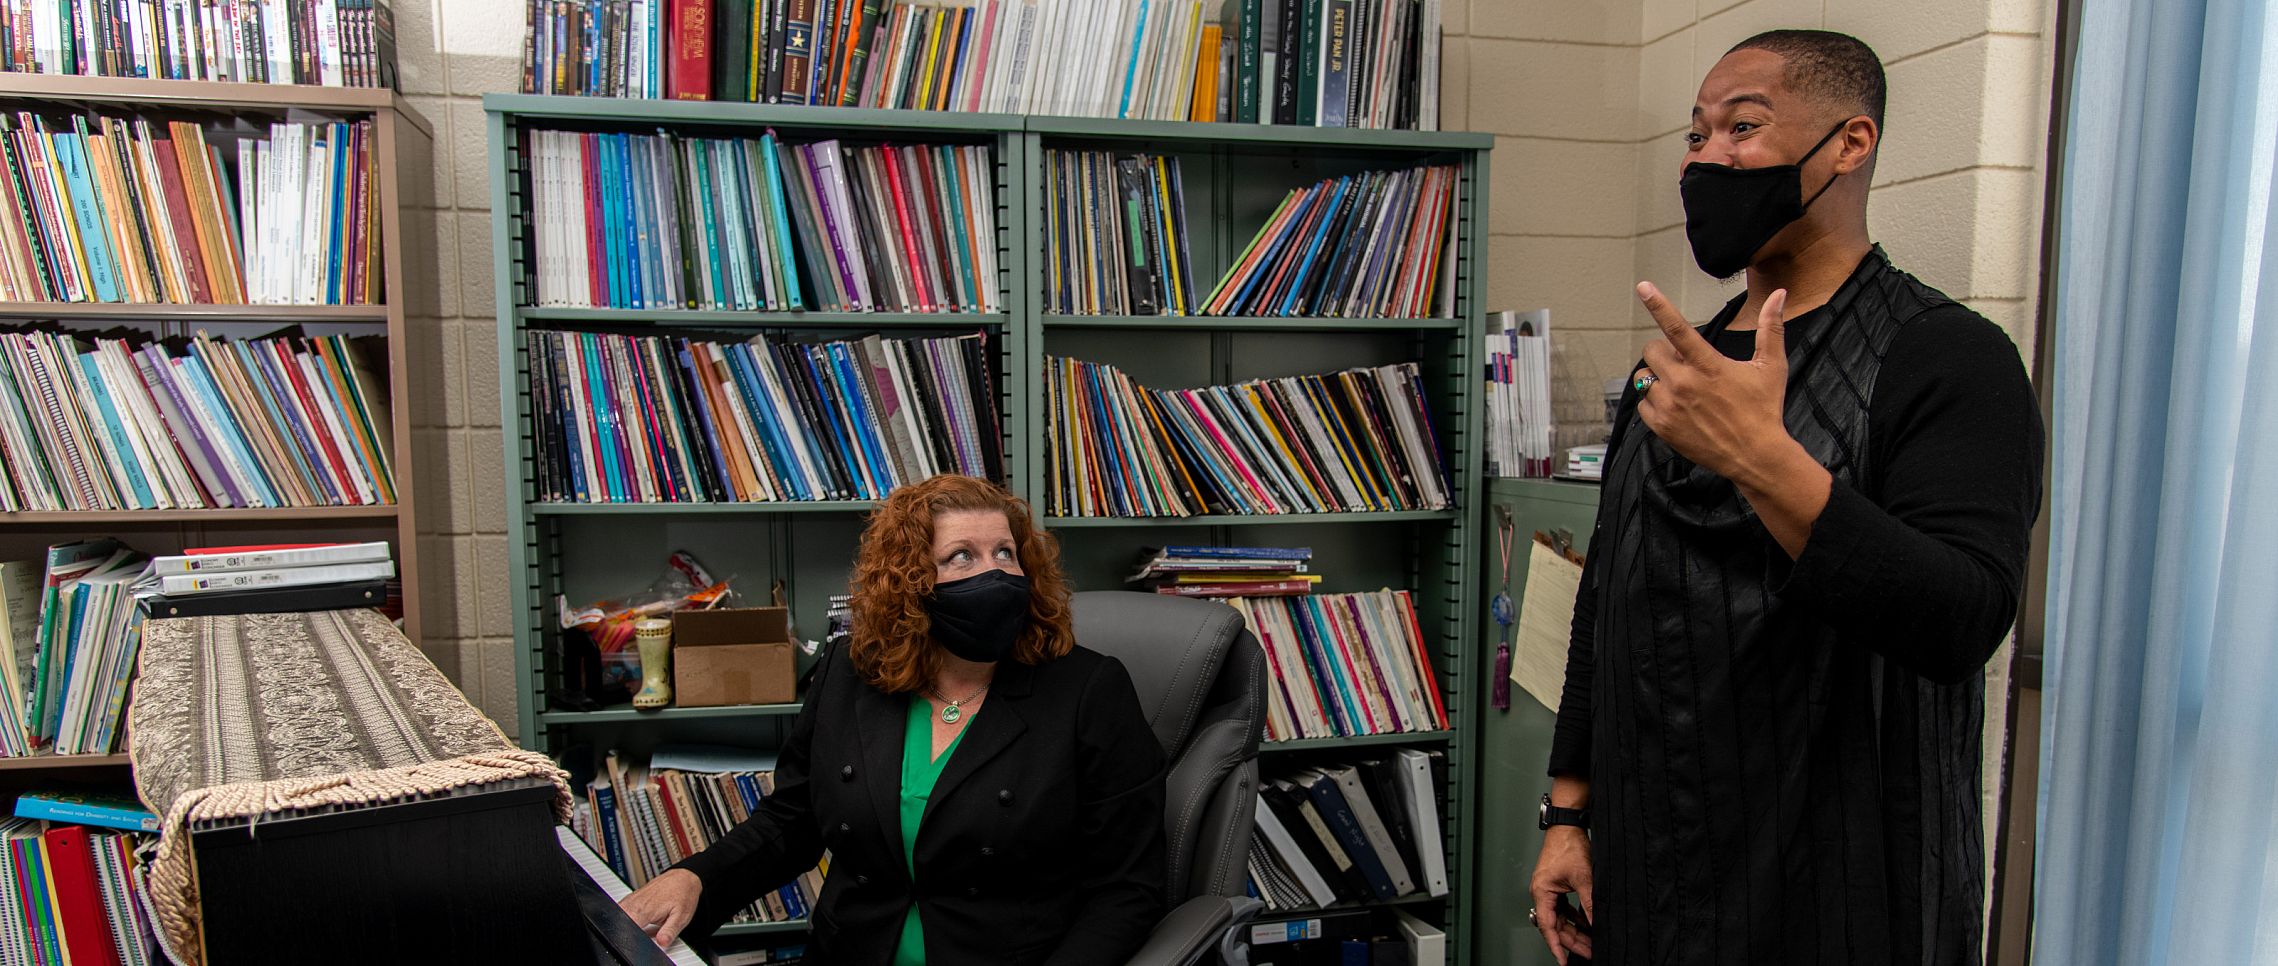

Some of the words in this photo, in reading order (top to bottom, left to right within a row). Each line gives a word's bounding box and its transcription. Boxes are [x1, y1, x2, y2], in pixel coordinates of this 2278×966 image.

[1333, 8, 1345, 37] PETER
[1332, 39, 1343, 57] PAN
[1331, 60, 1341, 73] JR.
[82, 209, 92, 230] SONGS
[91, 246, 101, 264] Volume
[97, 272, 106, 285] High
